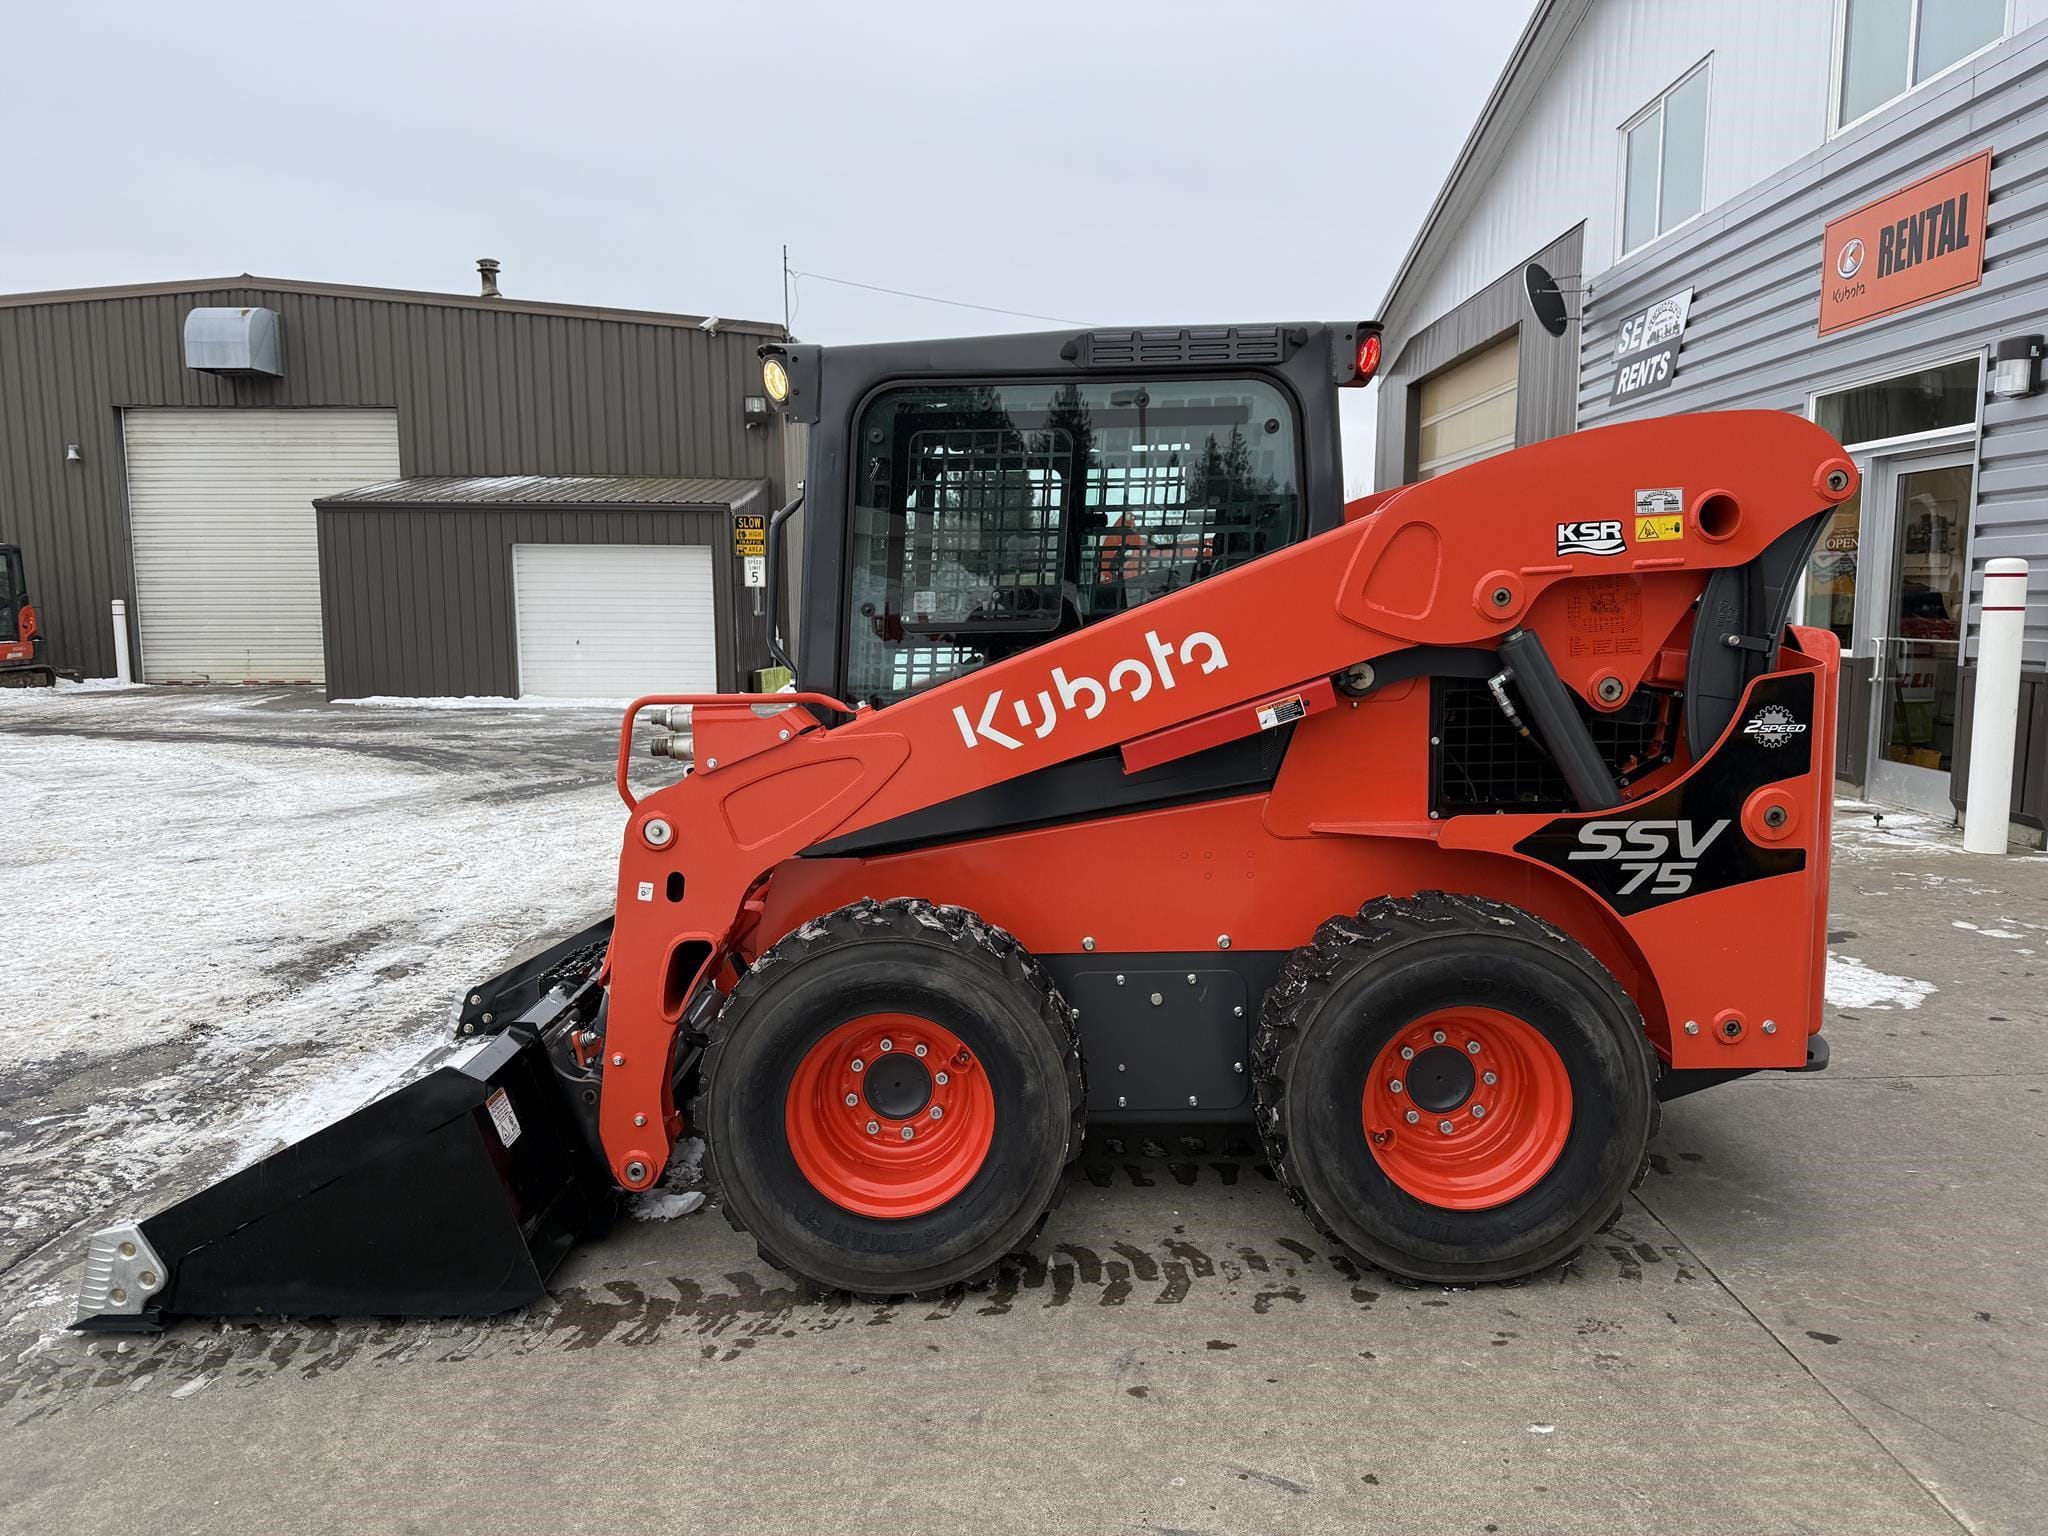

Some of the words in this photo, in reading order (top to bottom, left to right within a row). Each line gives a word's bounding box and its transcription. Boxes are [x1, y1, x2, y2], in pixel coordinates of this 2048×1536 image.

[1877, 191, 1969, 279] RENTAL
[1832, 281, 1866, 303] Kubota
[1618, 314, 1645, 353] SE
[1616, 350, 1671, 395] RENTS
[738, 517, 761, 528] SLOW
[1557, 520, 1622, 542] KSR
[751, 571, 759, 583] 5
[952, 630, 1230, 750] Kubota
[1568, 819, 1732, 860] SSV
[1616, 862, 1696, 895] 75
